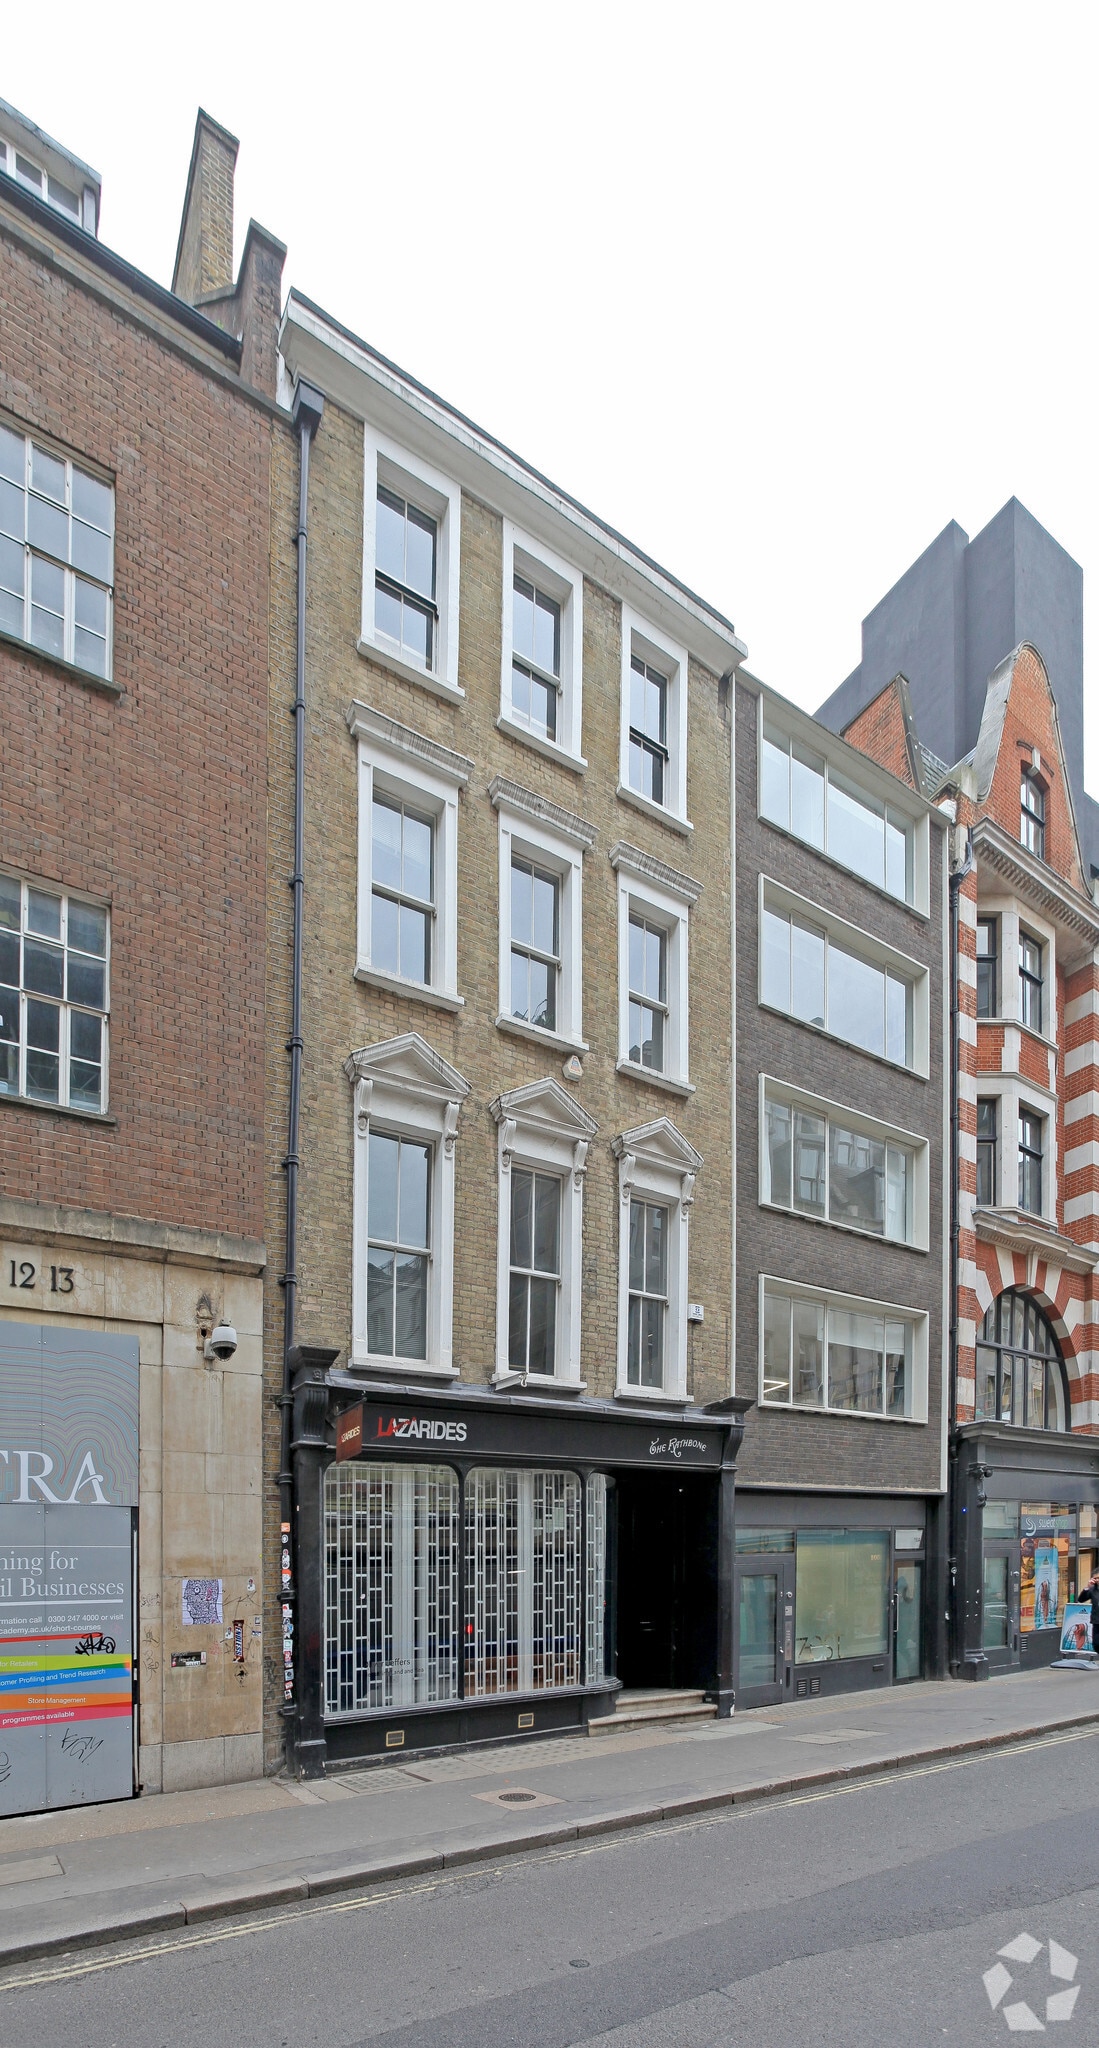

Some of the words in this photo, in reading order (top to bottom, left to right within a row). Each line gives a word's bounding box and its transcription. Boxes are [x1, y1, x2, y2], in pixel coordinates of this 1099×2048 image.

[9, 1259, 36, 1289] 12
[50, 1265, 75, 1293] 13
[376, 1416, 467, 1442] LAZARIDES
[0, 1450, 111, 1504] RA
[49, 1550, 79, 1570] for
[20, 1577, 124, 1598] Businesses
[29, 1616, 43, 1624] call
[48, 1615, 66, 1623] 0300
[68, 1614, 80, 1622] 247
[82, 1614, 99, 1622] 4000
[109, 1613, 124, 1621] visit
[19, 1674, 45, 1685] Profiling
[60, 1671, 77, 1679] Trend
[78, 1668, 106, 1677] Research
[46, 1697, 86, 1705] Management
[2, 1711, 45, 1725] programmes
[46, 1710, 75, 1720] available
